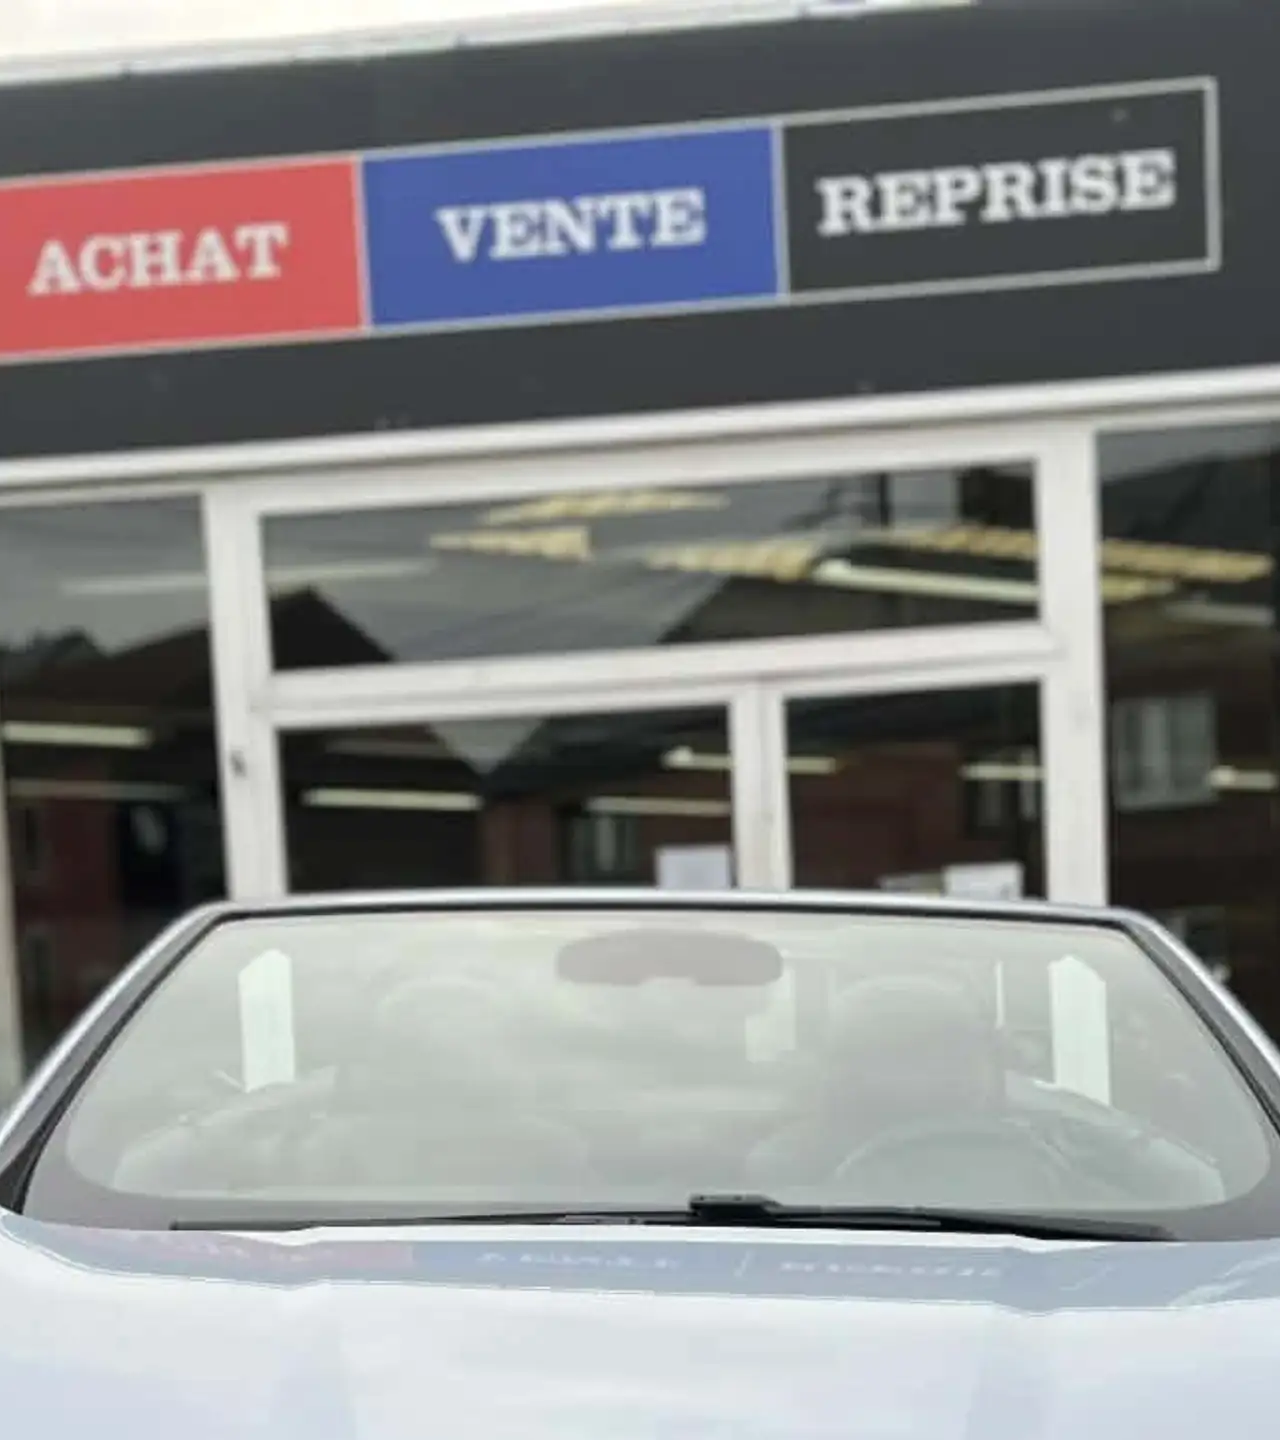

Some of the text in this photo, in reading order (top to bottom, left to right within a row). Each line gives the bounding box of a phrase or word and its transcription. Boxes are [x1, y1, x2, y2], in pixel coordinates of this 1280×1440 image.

[436, 188, 706, 261] VENTE
[816, 149, 1176, 236] REPRISE
[30, 223, 288, 295] ACHAT
